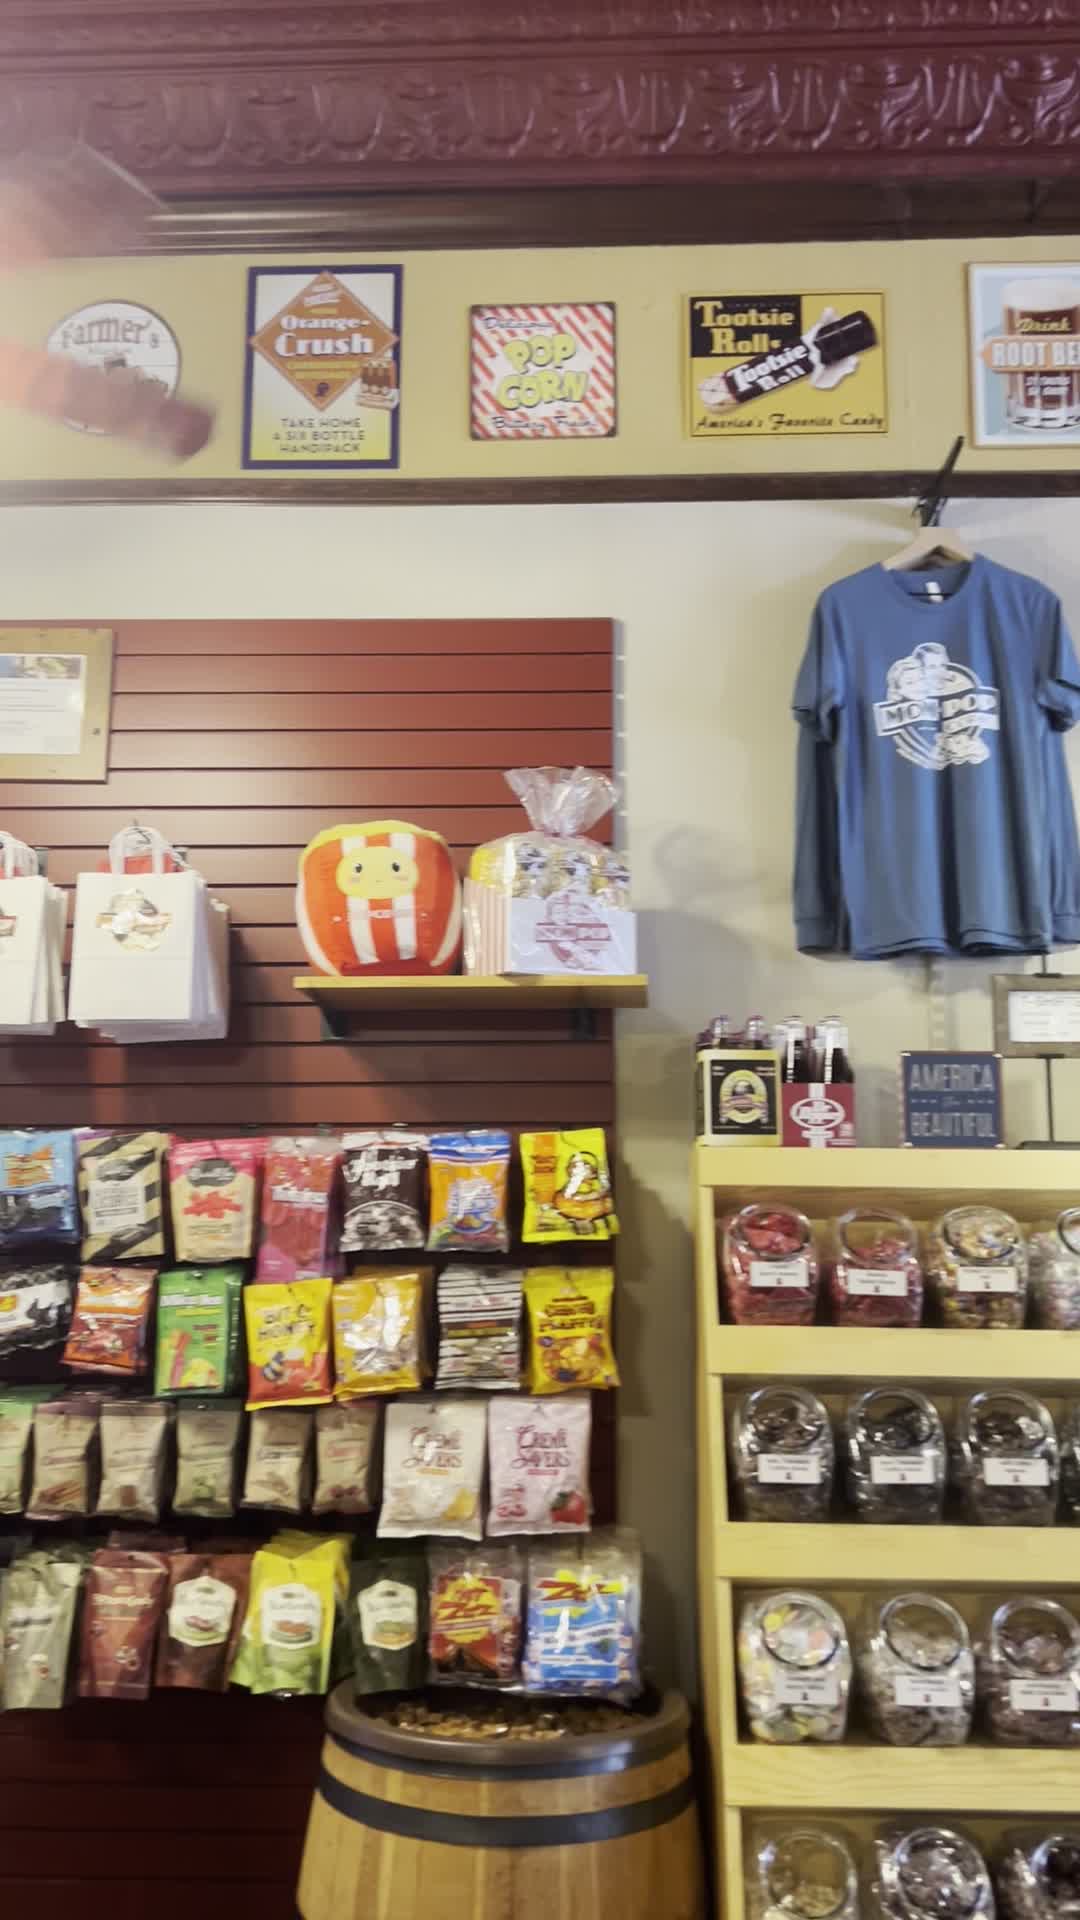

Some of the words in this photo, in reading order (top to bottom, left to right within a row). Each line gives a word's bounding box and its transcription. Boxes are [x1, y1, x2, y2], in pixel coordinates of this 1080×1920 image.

[694, 300, 795, 327] Tootsie
[1015, 317, 1072, 332] Drink
[61, 315, 160, 349] Farmer's
[274, 333, 374, 356] Crush
[502, 333, 577, 375] POP
[991, 342, 1046, 369] ROOT
[725, 344, 809, 392] Tootsie
[755, 363, 806, 392] Roll
[497, 368, 589, 411] CORN
[281, 417, 314, 428] TAKE
[319, 417, 361, 428] HOME
[697, 415, 763, 431] America's
[768, 413, 834, 431] Favorite
[840, 412, 885, 429] Candy
[285, 431, 307, 441] SIX
[311, 430, 365, 441] BOTTLE
[909, 1063, 995, 1091] AMERICA
[909, 1111, 995, 1138] BEAUTIFUL
